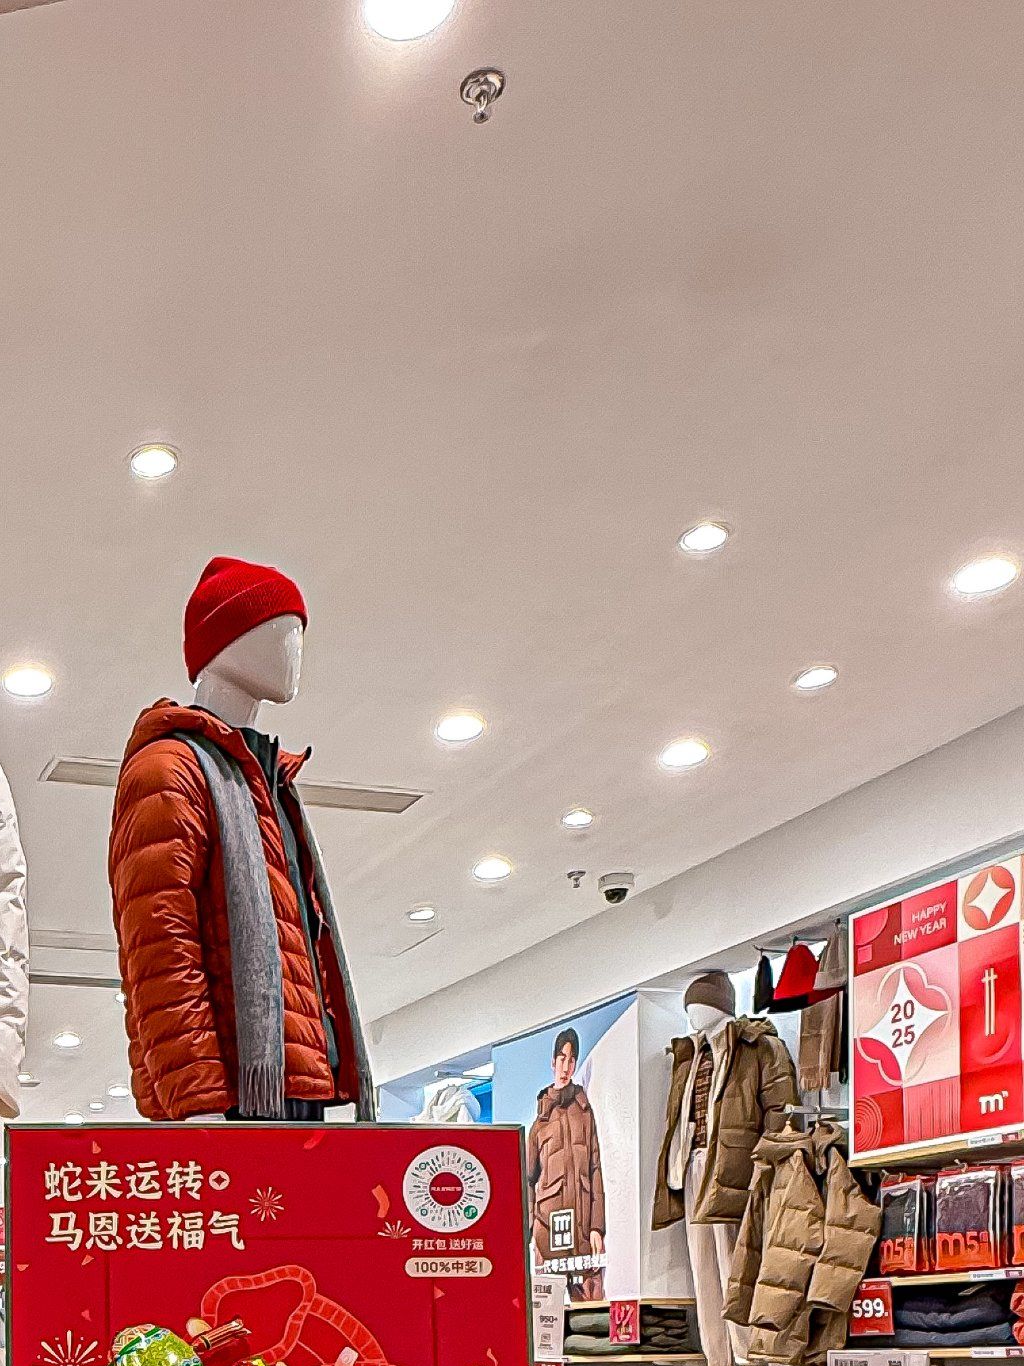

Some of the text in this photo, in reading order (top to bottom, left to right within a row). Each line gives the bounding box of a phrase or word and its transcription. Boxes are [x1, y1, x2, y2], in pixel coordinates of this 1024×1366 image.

[911, 901, 947, 924] HAPPY
[893, 917, 947, 946] NEW YEAR
[890, 1000, 915, 1024] 20
[891, 1025, 915, 1048] 25
[44, 1161, 204, 1202] 蛇来运转
[44, 1210, 245, 1251] 马恩送福气
[412, 1239, 446, 1251] 开红包
[414, 1261, 483, 1274] 100%中奖!
